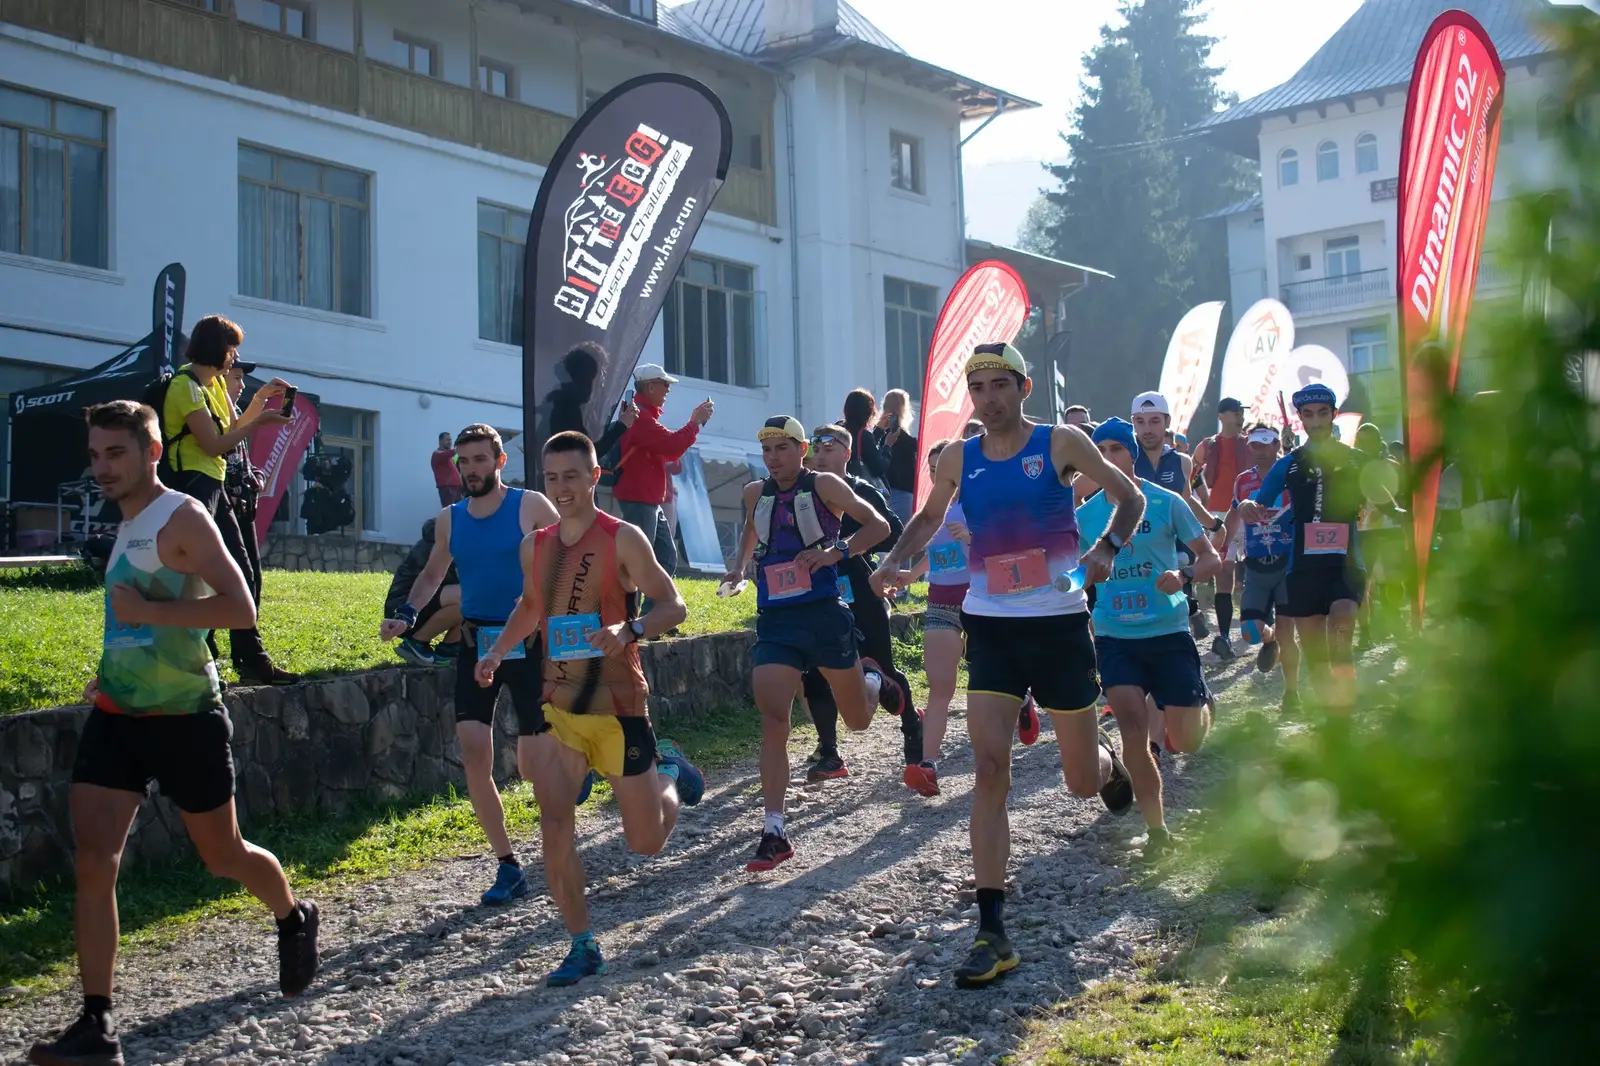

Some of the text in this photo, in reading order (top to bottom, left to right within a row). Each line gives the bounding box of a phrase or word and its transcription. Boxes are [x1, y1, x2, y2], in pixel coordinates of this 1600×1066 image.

[1470, 86, 1494, 184] distribution
[554, 123, 669, 320] HIT THE EGG!
[630, 149, 682, 243] Challenge
[1412, 54, 1478, 322] Dinamic 92
[639, 196, 697, 299] www.hte.run
[165, 273, 175, 362] SCOTT
[935, 306, 992, 400] Dinamic
[985, 280, 1006, 310] 92
[25, 391, 76, 408] SCOTT
[1250, 363, 1278, 418] Store
[262, 422, 292, 478] inamic
[1315, 530, 1338, 544] 52
[776, 568, 797, 587] 73
[1009, 563, 1021, 584] 1
[1112, 593, 1149, 611] 818
